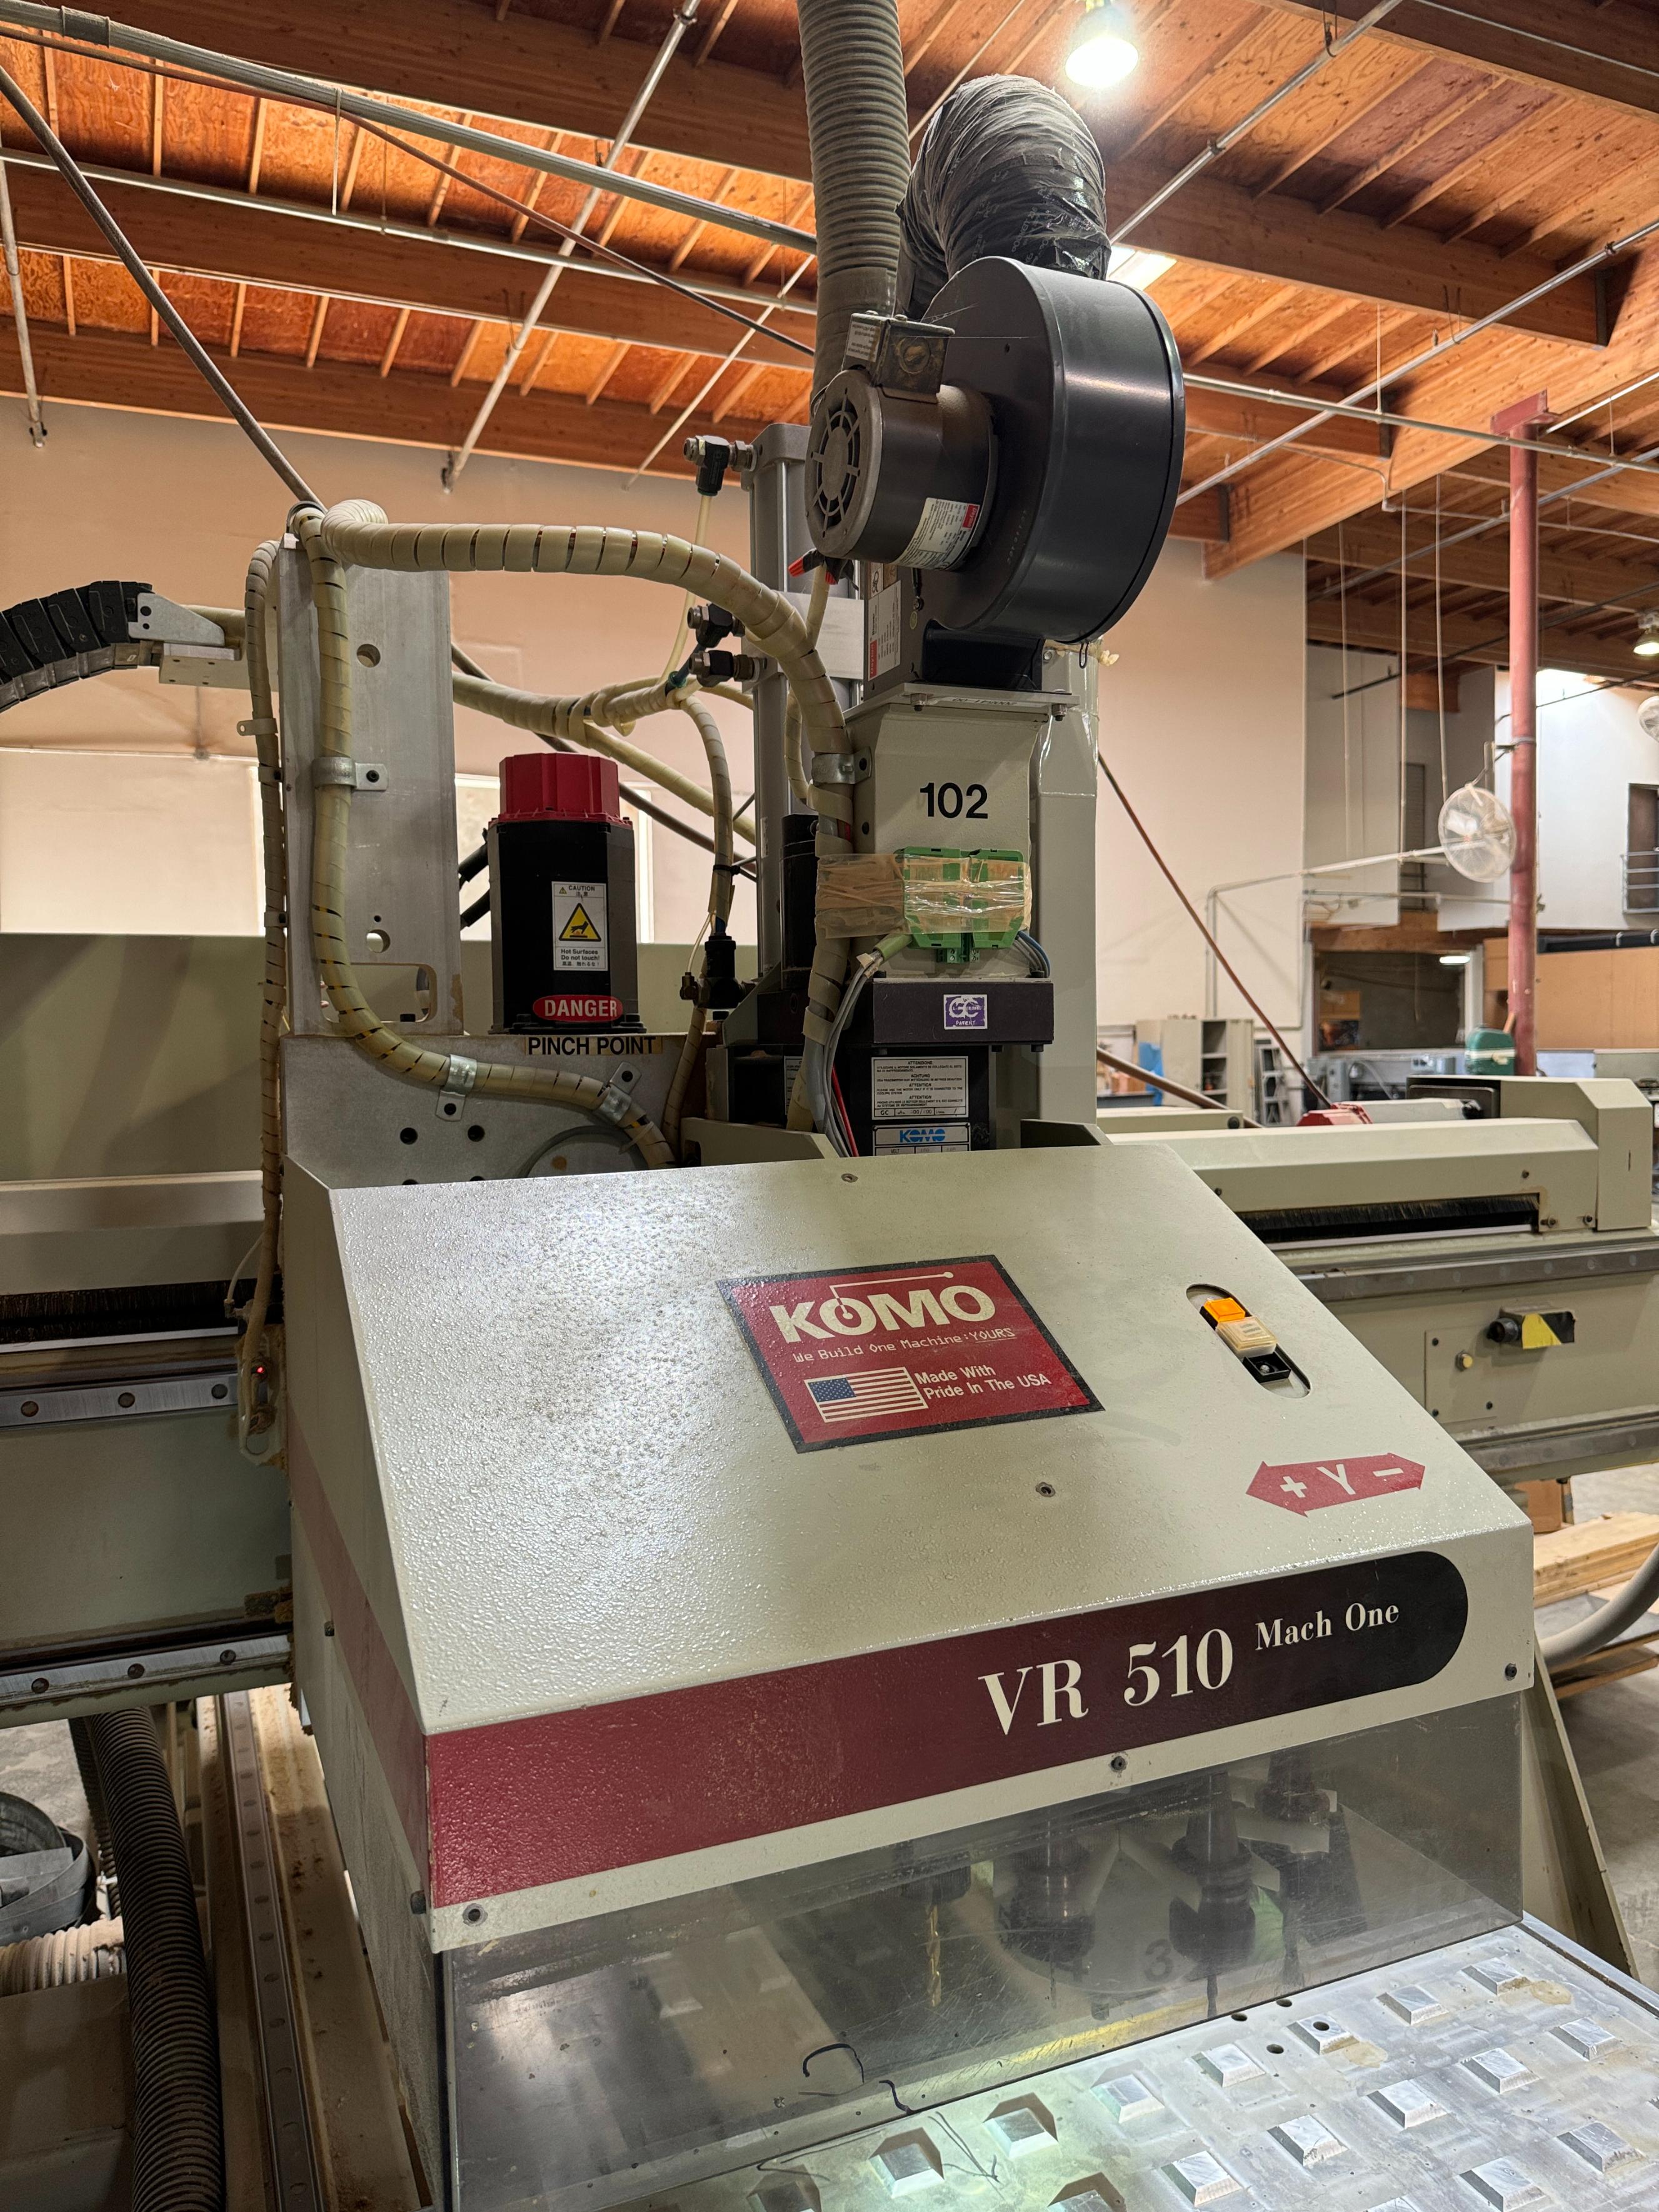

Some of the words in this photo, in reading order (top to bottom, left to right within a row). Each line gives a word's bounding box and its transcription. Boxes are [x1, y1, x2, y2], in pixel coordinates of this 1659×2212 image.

[920, 782, 988, 818] 102
[544, 1000, 618, 1017] DANGER
[528, 1037, 589, 1055] PINCH
[598, 1036, 656, 1055] POINT
[900, 1129, 946, 1143] KOMO
[769, 1285, 996, 1343] KOMO
[793, 1352, 814, 1363] We
[819, 1345, 863, 1360] Build
[869, 1342, 896, 1353] One
[914, 1370, 958, 1384] Made
[960, 1365, 996, 1378] With
[923, 1385, 965, 1399] Pride
[966, 1382, 983, 1394] In
[984, 1379, 1015, 1391] The
[1016, 1373, 1053, 1387] USA
[978, 1659, 1088, 1736] VR
[1123, 1628, 1233, 1707] 510
[1255, 1610, 1332, 1651] Mach
[1345, 1602, 1400, 1631] One
[1144, 1939, 1173, 1983] 3
